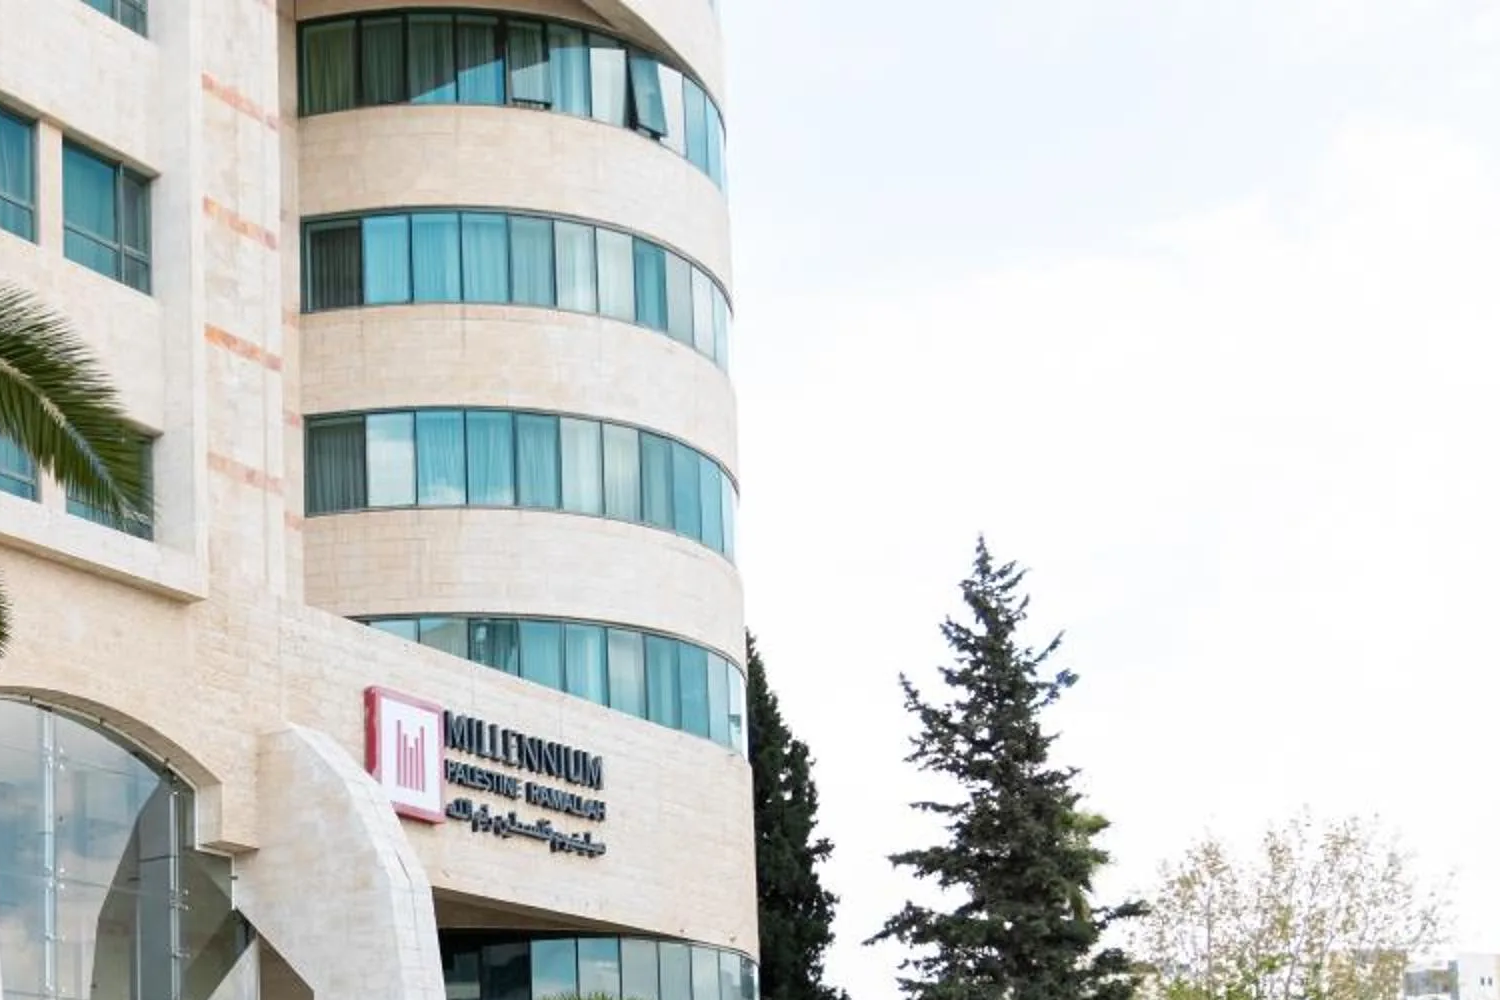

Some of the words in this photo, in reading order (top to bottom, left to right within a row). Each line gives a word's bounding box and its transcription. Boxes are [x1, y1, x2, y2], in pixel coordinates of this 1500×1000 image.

[444, 710, 603, 790] MILLENNIUM
[444, 759, 522, 799] PALESTINE
[525, 782, 606, 822] RAMALLAH
